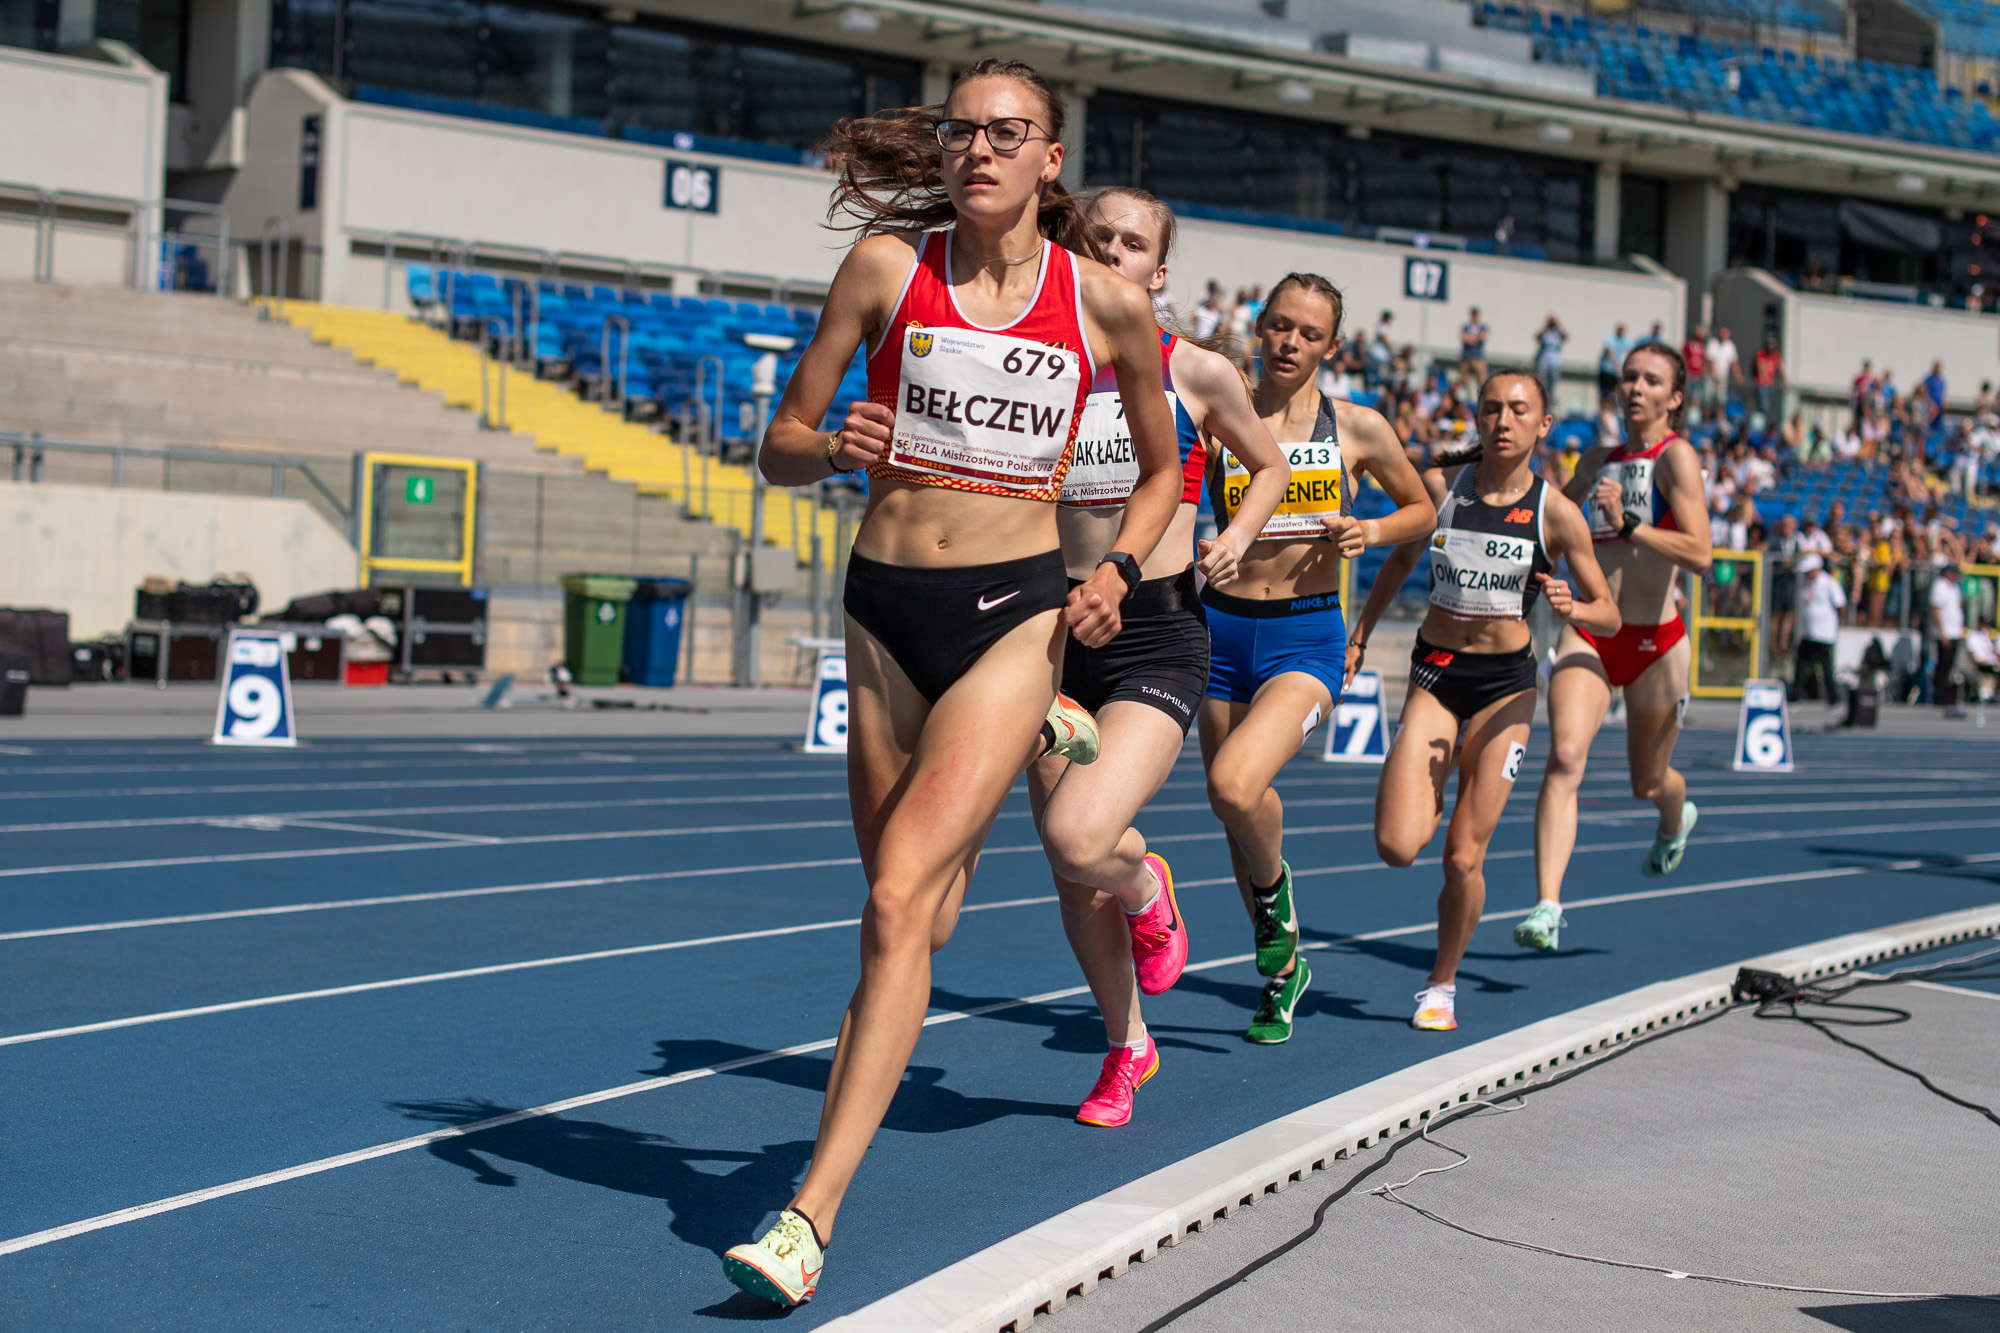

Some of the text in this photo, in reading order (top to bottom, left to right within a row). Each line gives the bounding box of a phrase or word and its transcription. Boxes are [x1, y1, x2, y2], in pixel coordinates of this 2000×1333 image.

[671, 166, 712, 209] 06
[1409, 261, 1443, 297] 07
[939, 345, 963, 356] Śląskie
[940, 336, 986, 350] Województwo
[1003, 347, 1066, 380] 679
[905, 382, 1066, 438] BEŁCZEW
[914, 442, 938, 456] PZLA
[940, 448, 1004, 468] Mistrzostwa
[1007, 460, 1036, 472] Polski
[1037, 463, 1054, 472] U18
[951, 442, 982, 453] Olimpiada
[1289, 448, 1330, 466] 613
[911, 458, 952, 472] CHORZÓW
[1080, 486, 1130, 496] Mistrzostwa
[1485, 540, 1523, 560] 824
[1435, 563, 1524, 591] OWCZARUK
[1290, 596, 1324, 611] NIKE
[229, 674, 282, 739] 9
[817, 689, 849, 747] 8
[1338, 704, 1379, 755] 7
[1746, 713, 1785, 768] 6
[1510, 748, 1524, 778] 3
